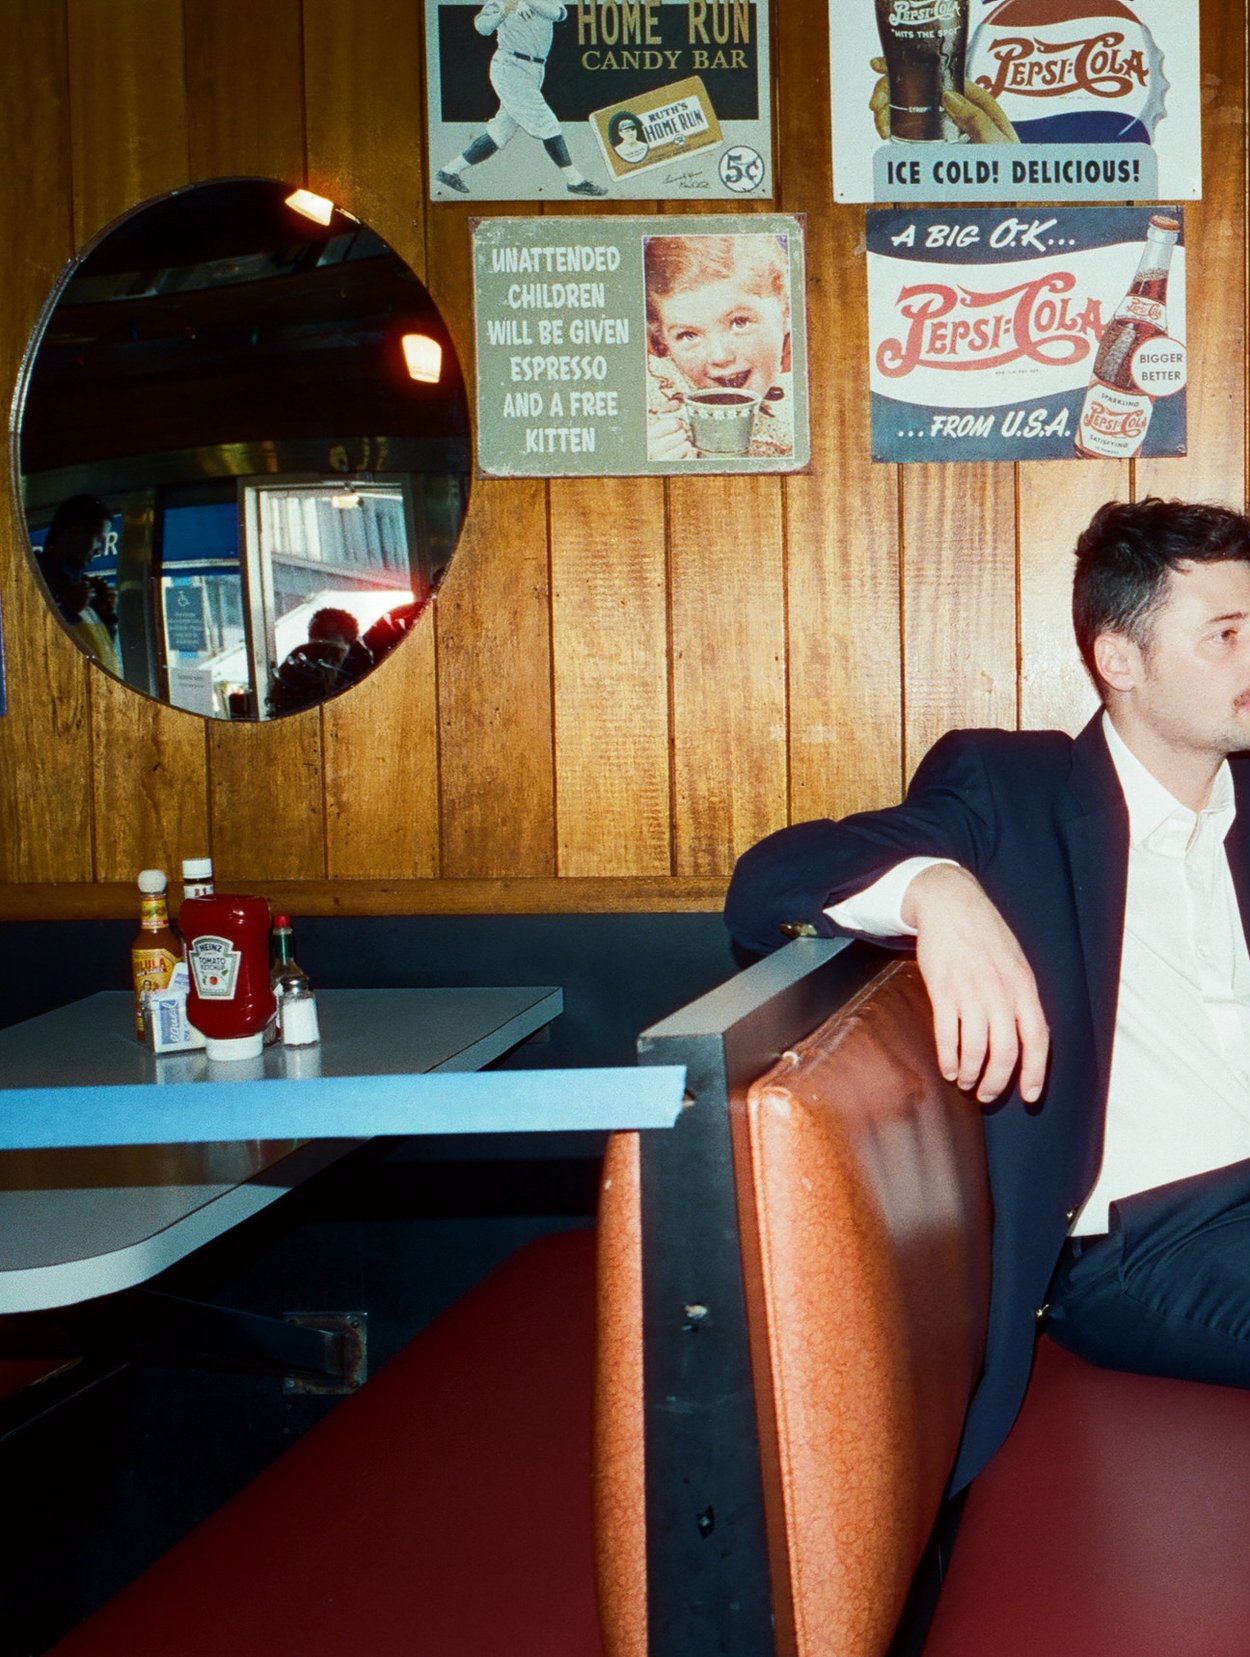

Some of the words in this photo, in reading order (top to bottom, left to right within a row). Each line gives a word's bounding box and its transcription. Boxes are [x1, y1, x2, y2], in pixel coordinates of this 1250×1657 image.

[577, 0, 662, 46] HOME
[688, 0, 750, 46] RUN
[917, 30, 935, 38] THE
[581, 51, 681, 71] CANDY
[692, 50, 749, 70] BAR
[648, 102, 688, 122] RUTH'S
[644, 117, 680, 143] HOME
[678, 109, 704, 131] RUN
[887, 161, 921, 184] ICE
[933, 160, 999, 184] COLD!
[1012, 160, 1140, 184] DELICIOUS!
[891, 225, 915, 247] A
[925, 225, 981, 248] BIG
[492, 246, 621, 273] UNATTENDED
[507, 283, 605, 309] CHILDREN
[487, 319, 533, 346] WILL
[538, 320, 563, 345] BE
[569, 318, 629, 345] GIVEN
[510, 356, 608, 382] ESPRESSO
[1140, 354, 1183, 363] BIGGER
[1142, 371, 1181, 381] BETTER
[503, 392, 544, 418] AND
[550, 391, 564, 417] A
[570, 391, 618, 417] FREE
[1101, 393, 1140, 407] SPARKLING
[1001, 409, 1071, 438] U.S.A.
[525, 427, 596, 453] KITTEN
[199, 943, 223, 953] HEINZ
[199, 957, 226, 965] TOMATO
[162, 1000, 178, 1043] equal
